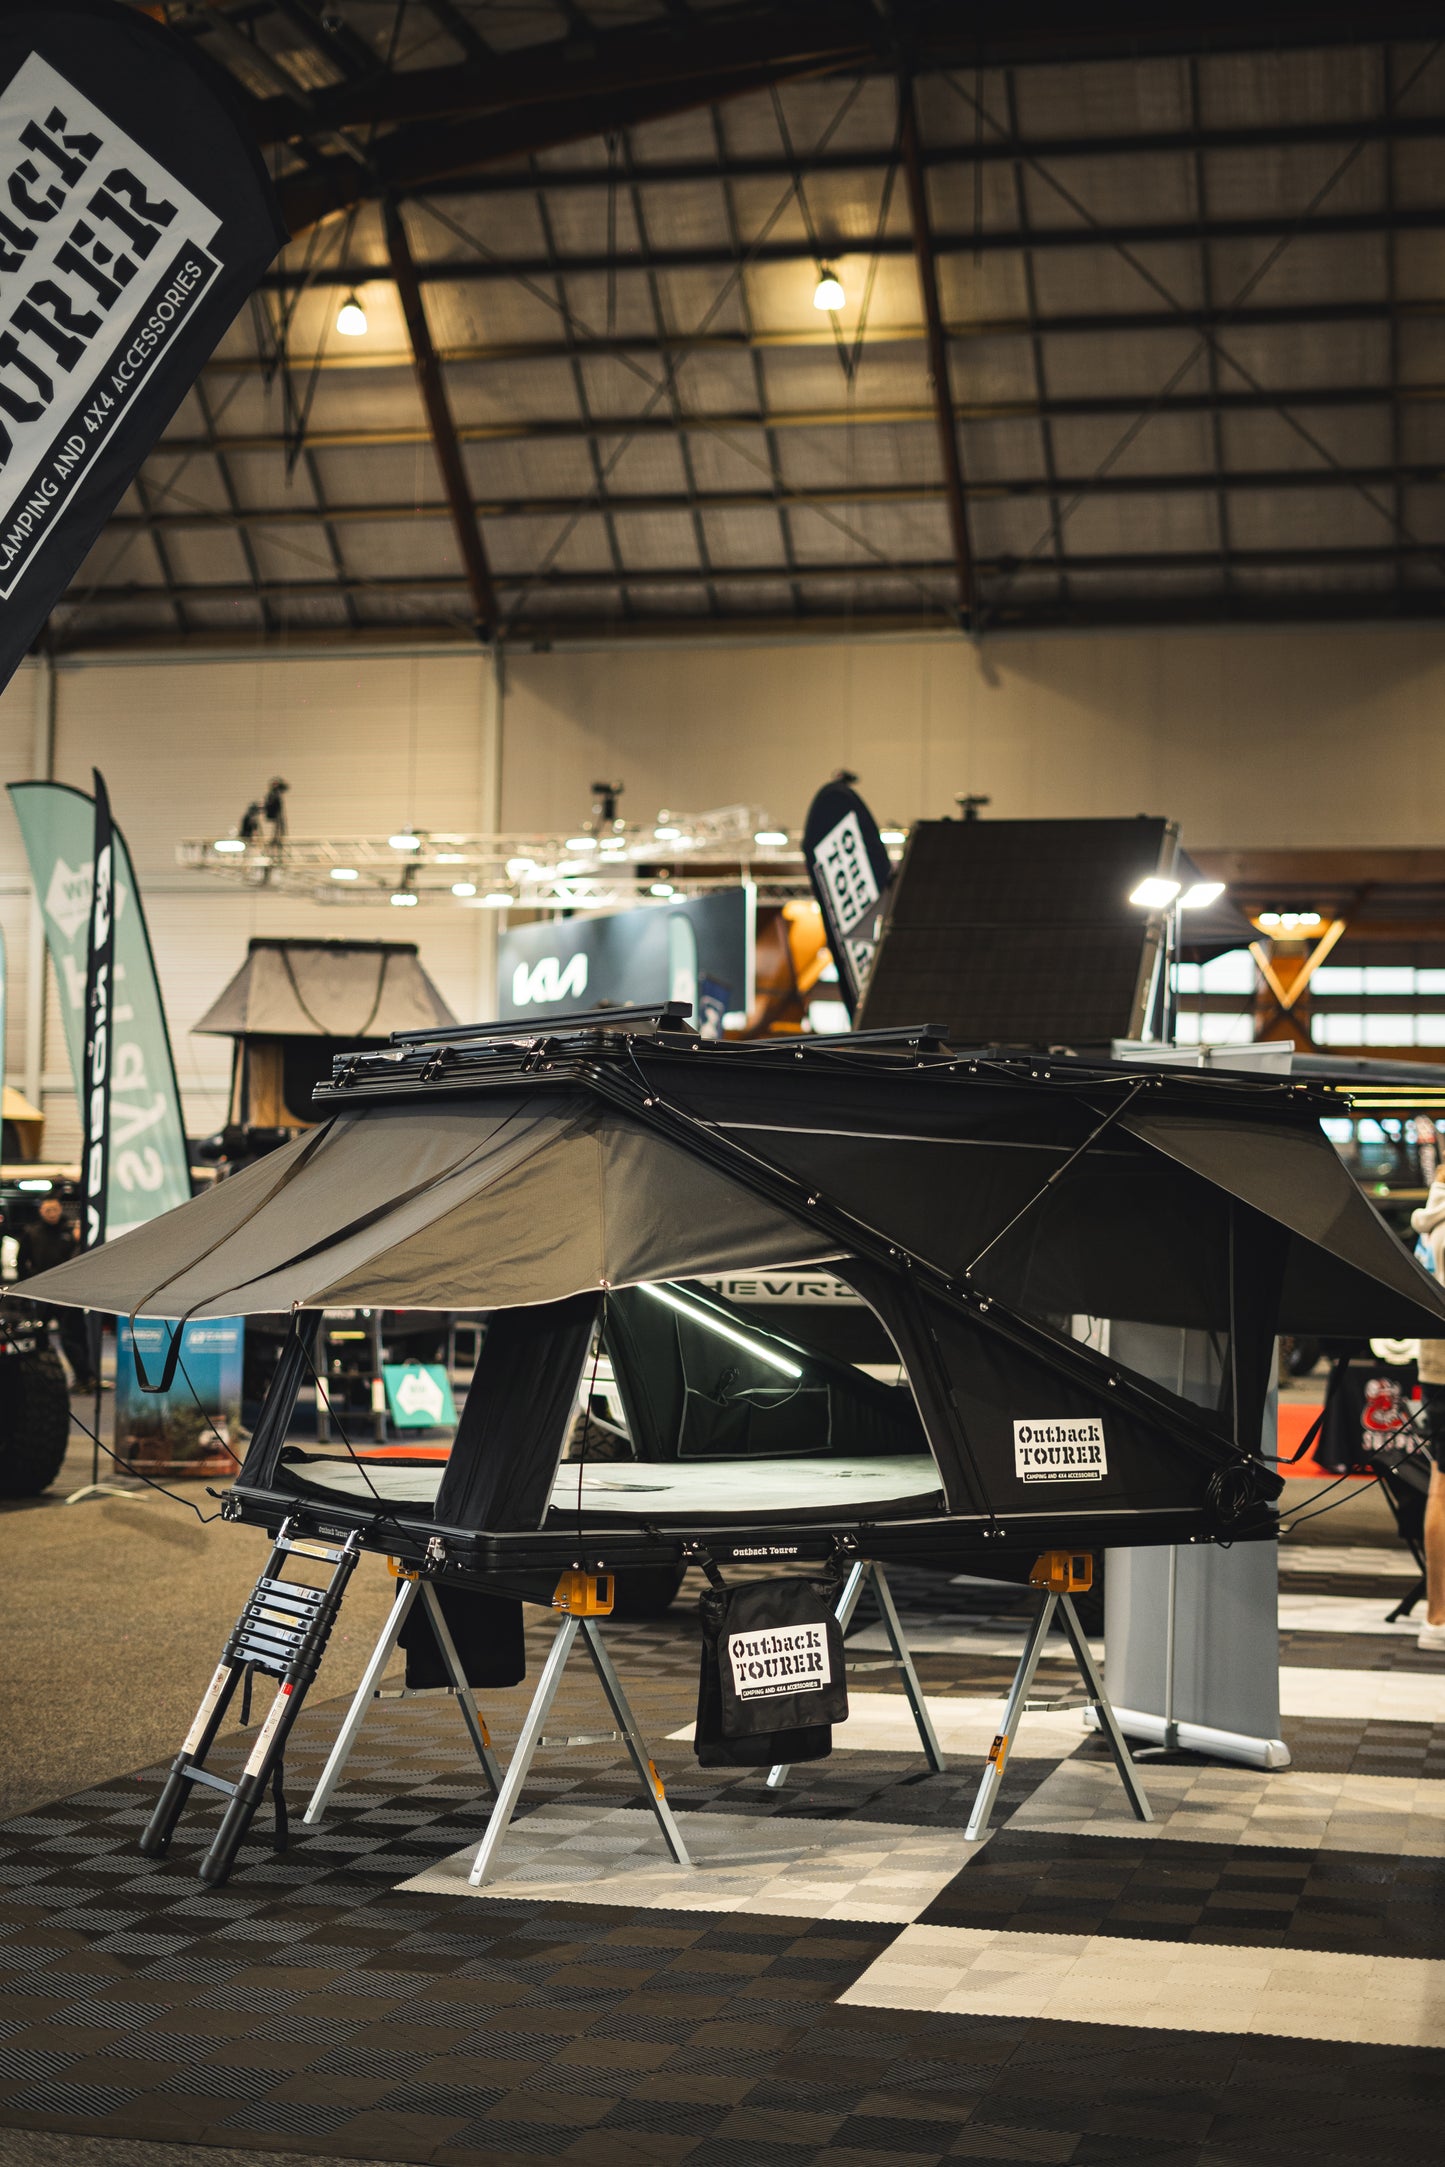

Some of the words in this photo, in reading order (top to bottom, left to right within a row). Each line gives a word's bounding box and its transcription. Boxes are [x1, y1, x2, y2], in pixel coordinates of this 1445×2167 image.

[0, 477, 59, 571] CAMPING
[53, 435, 86, 481] AND
[84, 392, 115, 433] 4X4
[111, 260, 203, 394] ACCESSORIES
[1018, 1425, 1100, 1443] Outback
[1019, 1445, 1102, 1465] TOURER
[733, 1547, 768, 1556] Outback
[769, 1546, 798, 1554] Tourer
[732, 1631, 821, 1659] Outback
[736, 1652, 823, 1682] TOURER
[742, 1688, 764, 1697] CAMPING
[787, 1681, 818, 1691] ACCESSORIES
